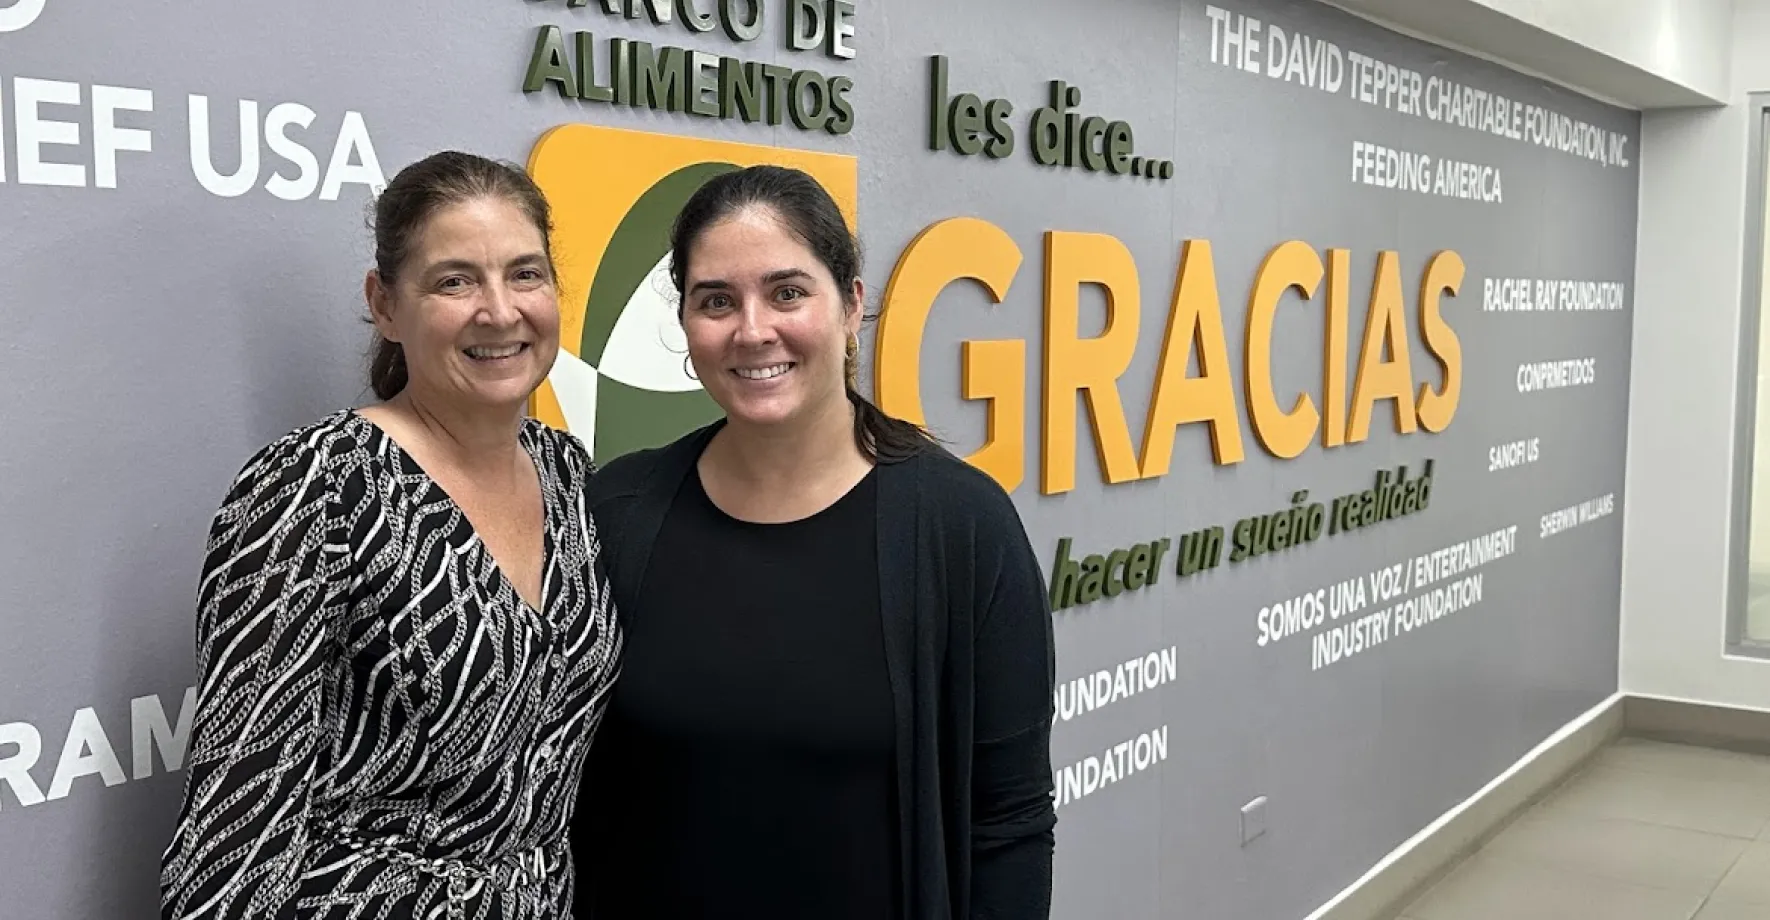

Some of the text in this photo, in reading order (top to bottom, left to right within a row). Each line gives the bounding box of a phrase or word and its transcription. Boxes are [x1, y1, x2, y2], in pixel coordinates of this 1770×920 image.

[523, 25, 856, 134] ALIMENTOS
[786, 0, 857, 59] DE
[928, 55, 1174, 180] les dice...
[1205, 4, 1261, 74] THE
[1267, 24, 1344, 93] DAVID
[1348, 50, 1422, 117] TEPPER
[1425, 75, 1521, 140] CHARITABLE
[1524, 104, 1607, 167] FOUNDATION,
[0, 75, 388, 201] EF USA
[1352, 140, 1503, 204] FEEDING AMERICA
[1484, 278, 1625, 311] RACHEL RAY FOUNDATION
[874, 216, 1466, 496] GRACIAS
[1489, 436, 1540, 472] SANOFI US
[1050, 458, 1435, 612] hacer un sueño realidad
[1540, 492, 1614, 539] SHERWIN WILLIAMS
[1257, 525, 1517, 647] SOMOS UNA VOZ / ENTERTAINMENT
[1312, 573, 1483, 671] INDUSTRY FOUNDATION
[1052, 645, 1177, 727] UNDATION
